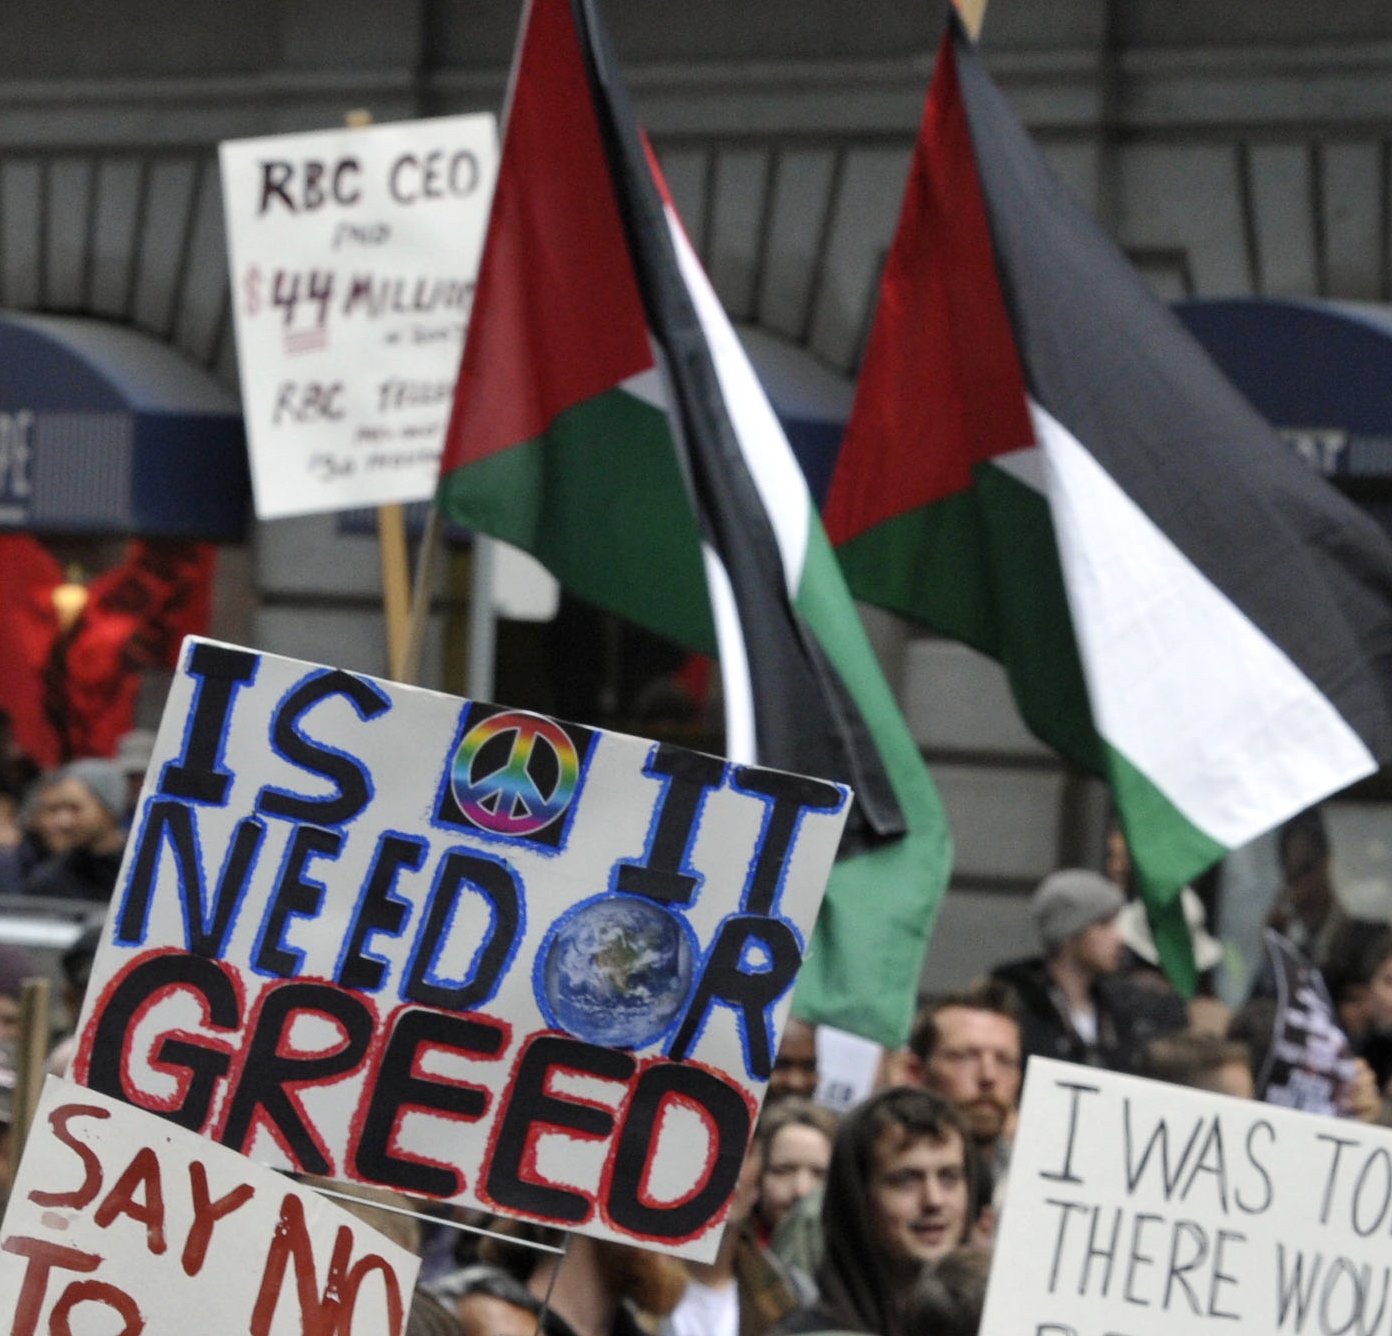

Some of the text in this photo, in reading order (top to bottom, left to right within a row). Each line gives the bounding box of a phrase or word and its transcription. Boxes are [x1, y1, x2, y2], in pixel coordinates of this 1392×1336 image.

[256, 148, 480, 218] RBC CEO
[272, 380, 348, 426] RBC
[157, 651, 854, 918] IS IT
[114, 797, 529, 1012] NEED
[72, 946, 760, 1247] GREED
[1038, 1081, 1100, 1185] I
[1123, 1098, 1277, 1216] WAS
[27, 1103, 255, 1277] SAY
[1044, 1198, 1248, 1320] THERE
